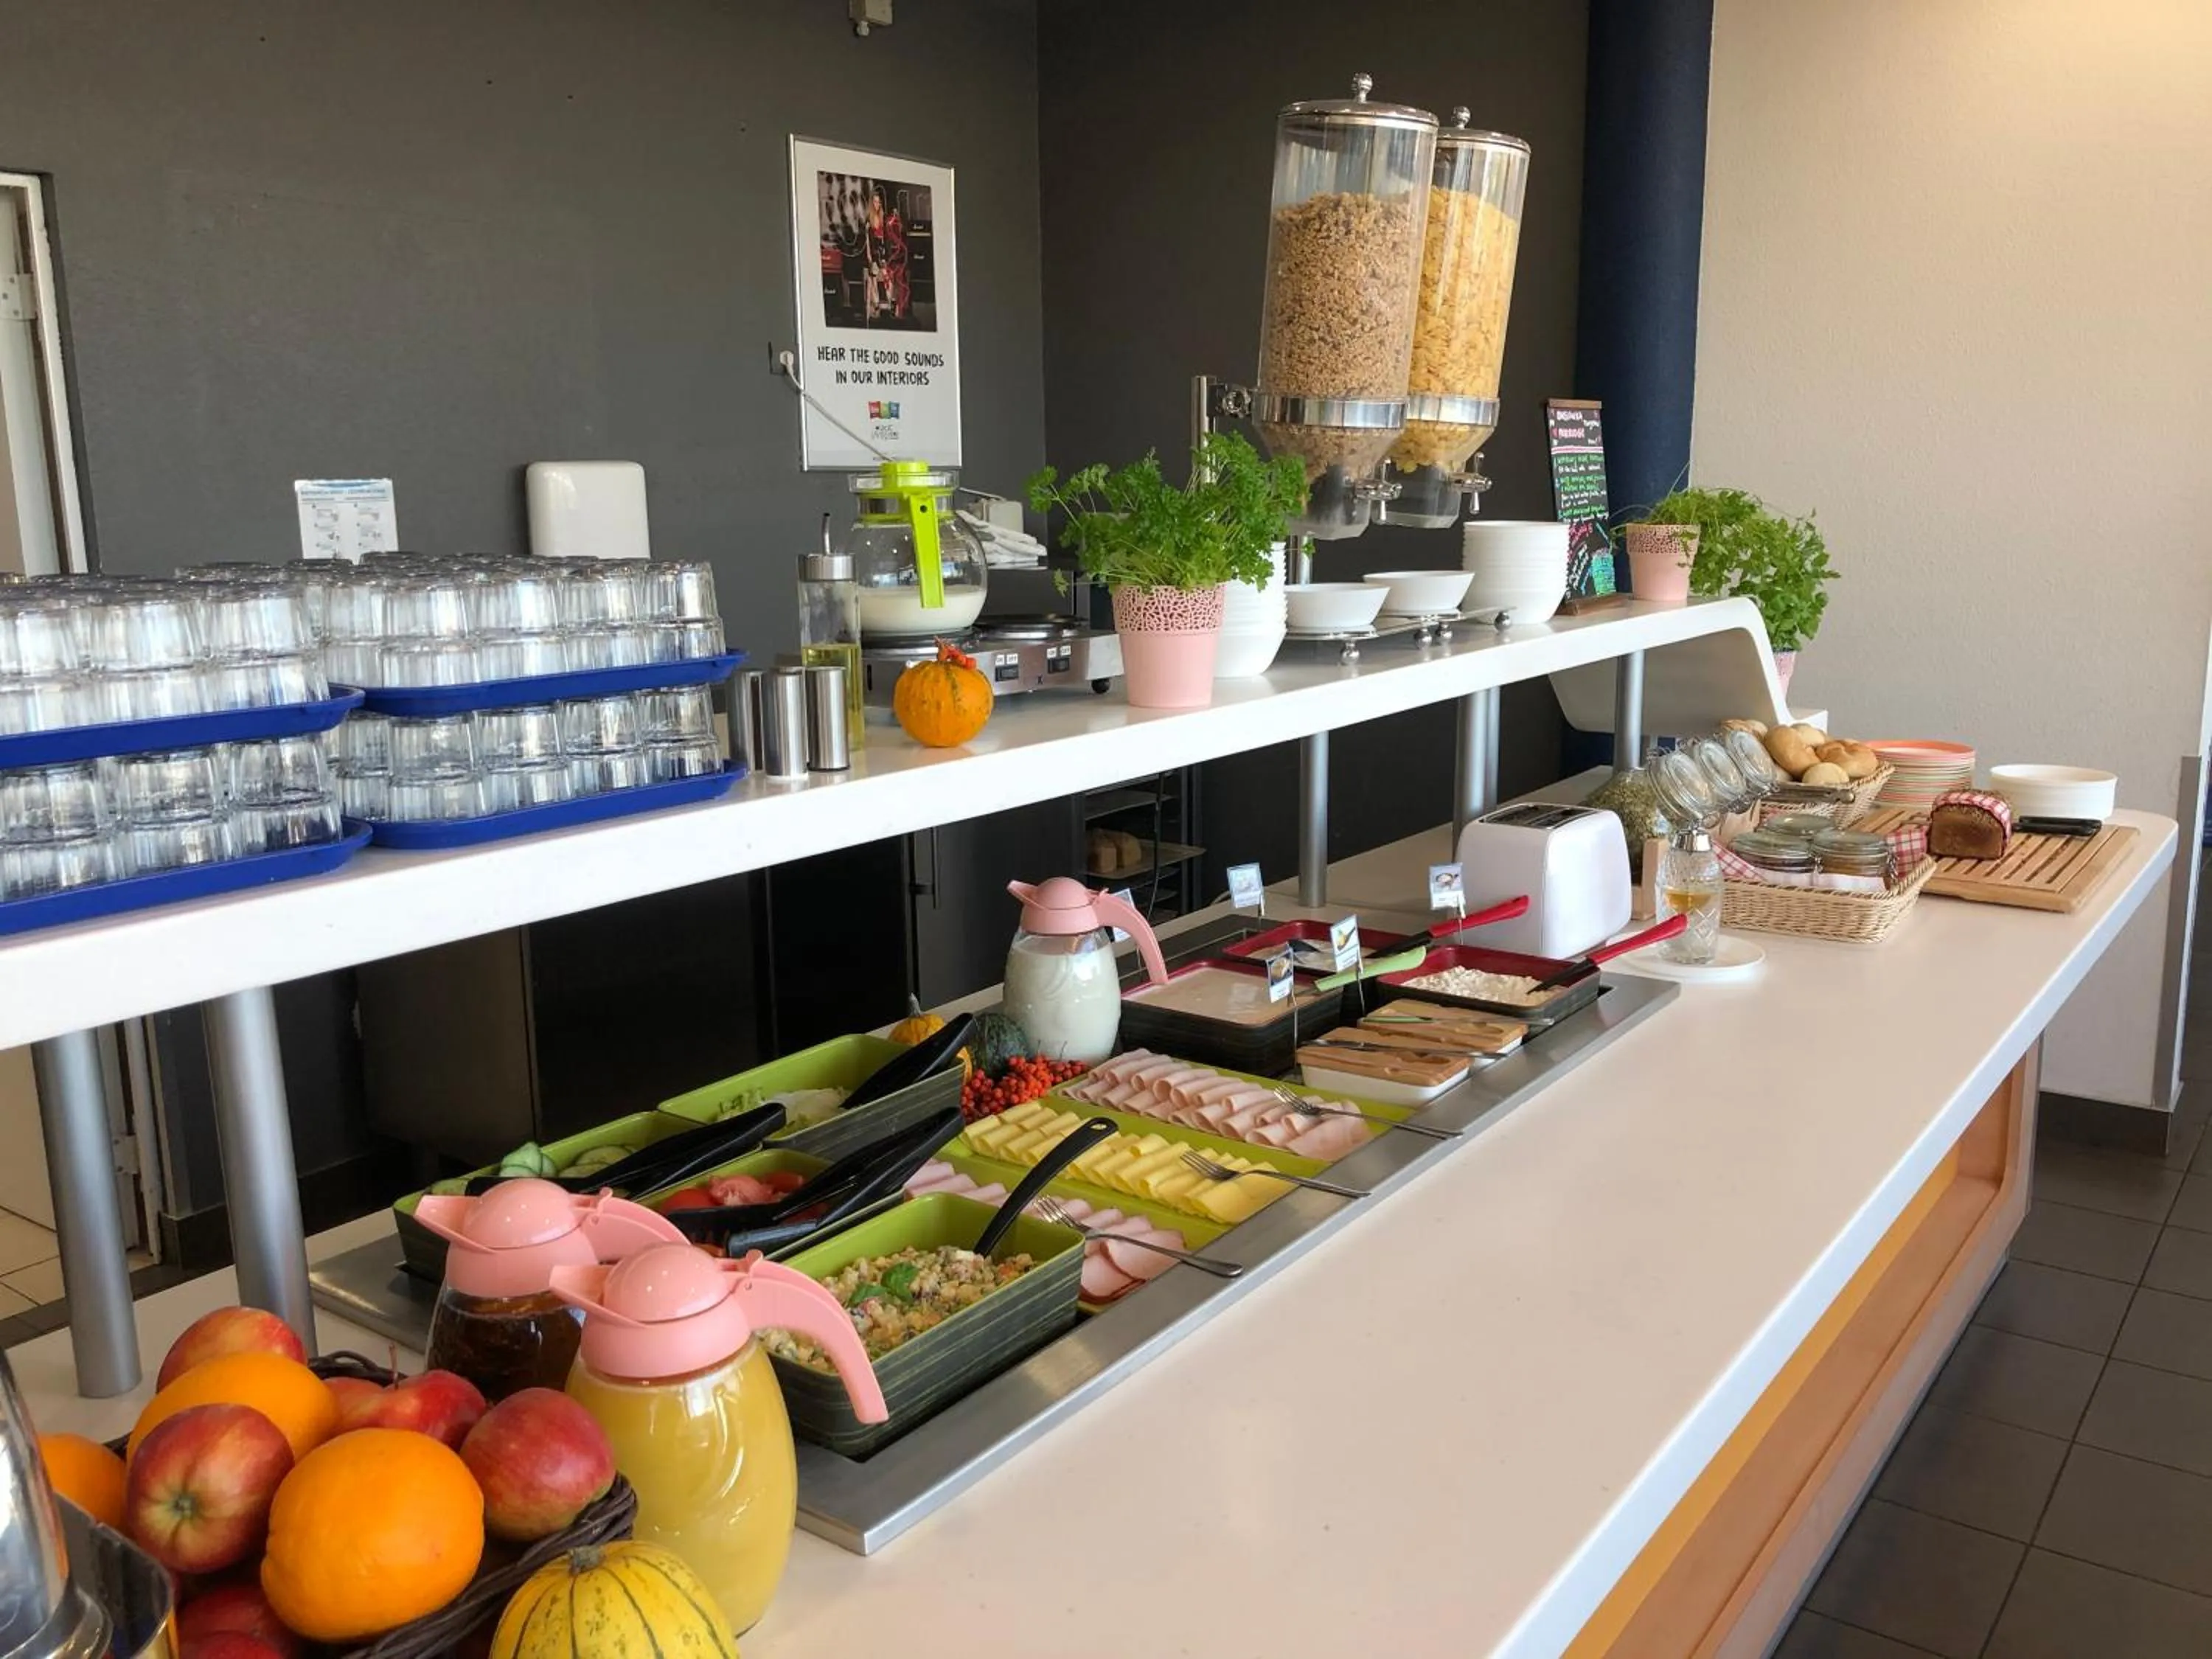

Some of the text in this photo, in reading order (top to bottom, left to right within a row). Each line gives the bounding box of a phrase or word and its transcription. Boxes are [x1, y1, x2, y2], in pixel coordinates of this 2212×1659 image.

[818, 346, 945, 367] HEAR THE GOOD SOUNDS
[835, 369, 930, 386] IN OUR INTERIORS
